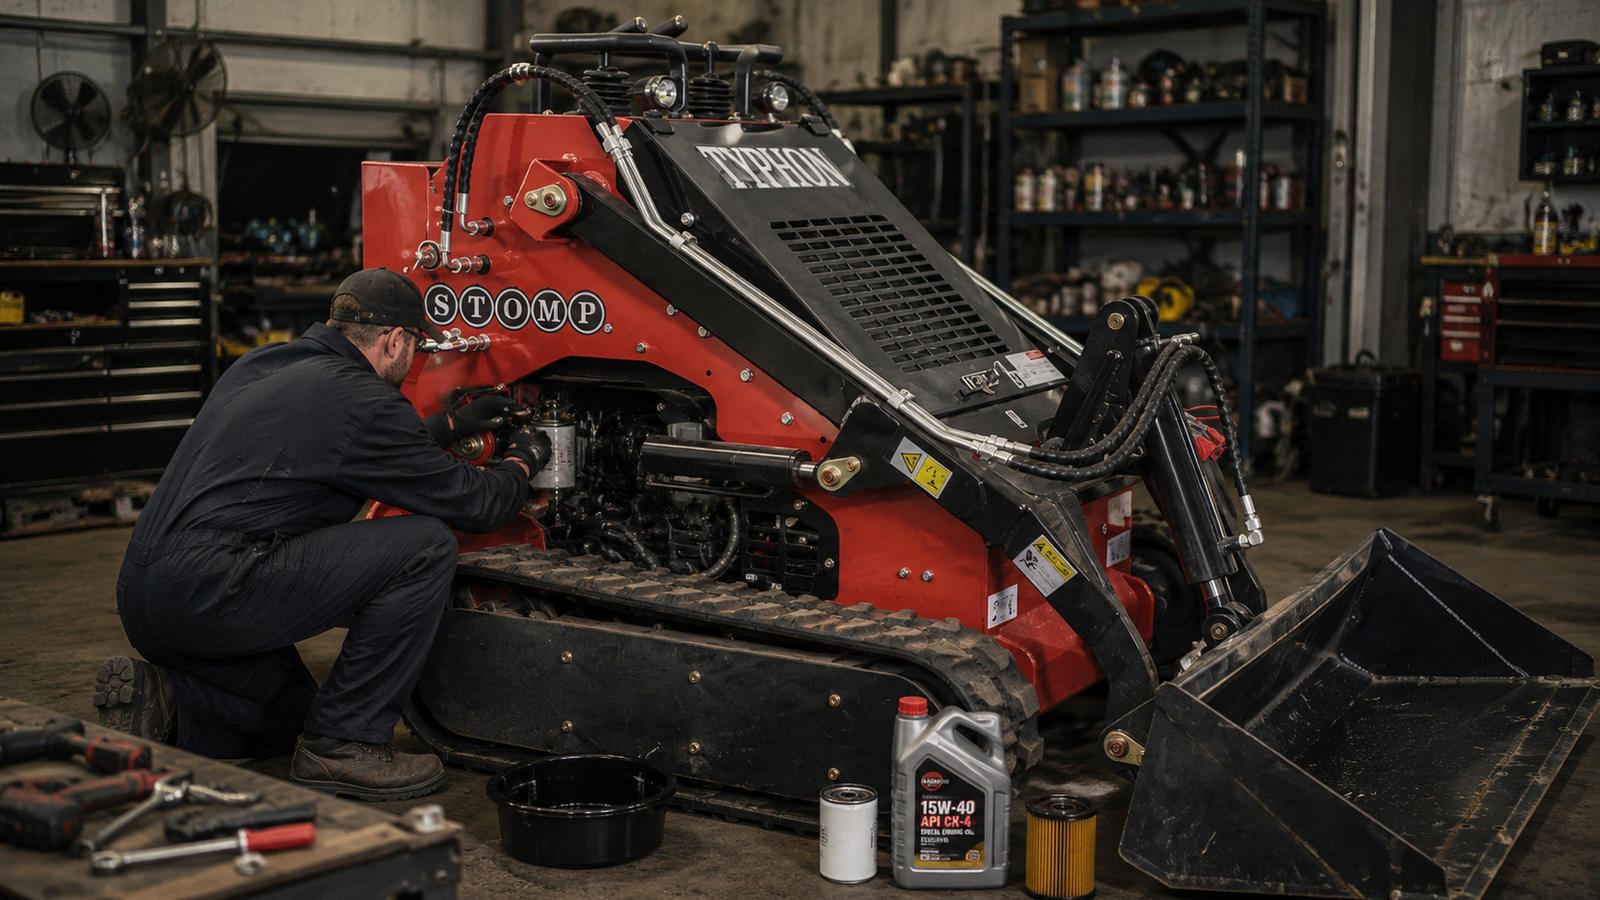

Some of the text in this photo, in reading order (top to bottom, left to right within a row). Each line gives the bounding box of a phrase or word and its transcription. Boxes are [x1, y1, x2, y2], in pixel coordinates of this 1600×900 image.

[695, 145, 851, 189] TYPHON
[433, 293, 597, 325] STOMP
[920, 800, 975, 815] 15W-40
[920, 816, 972, 828] API CK-4
